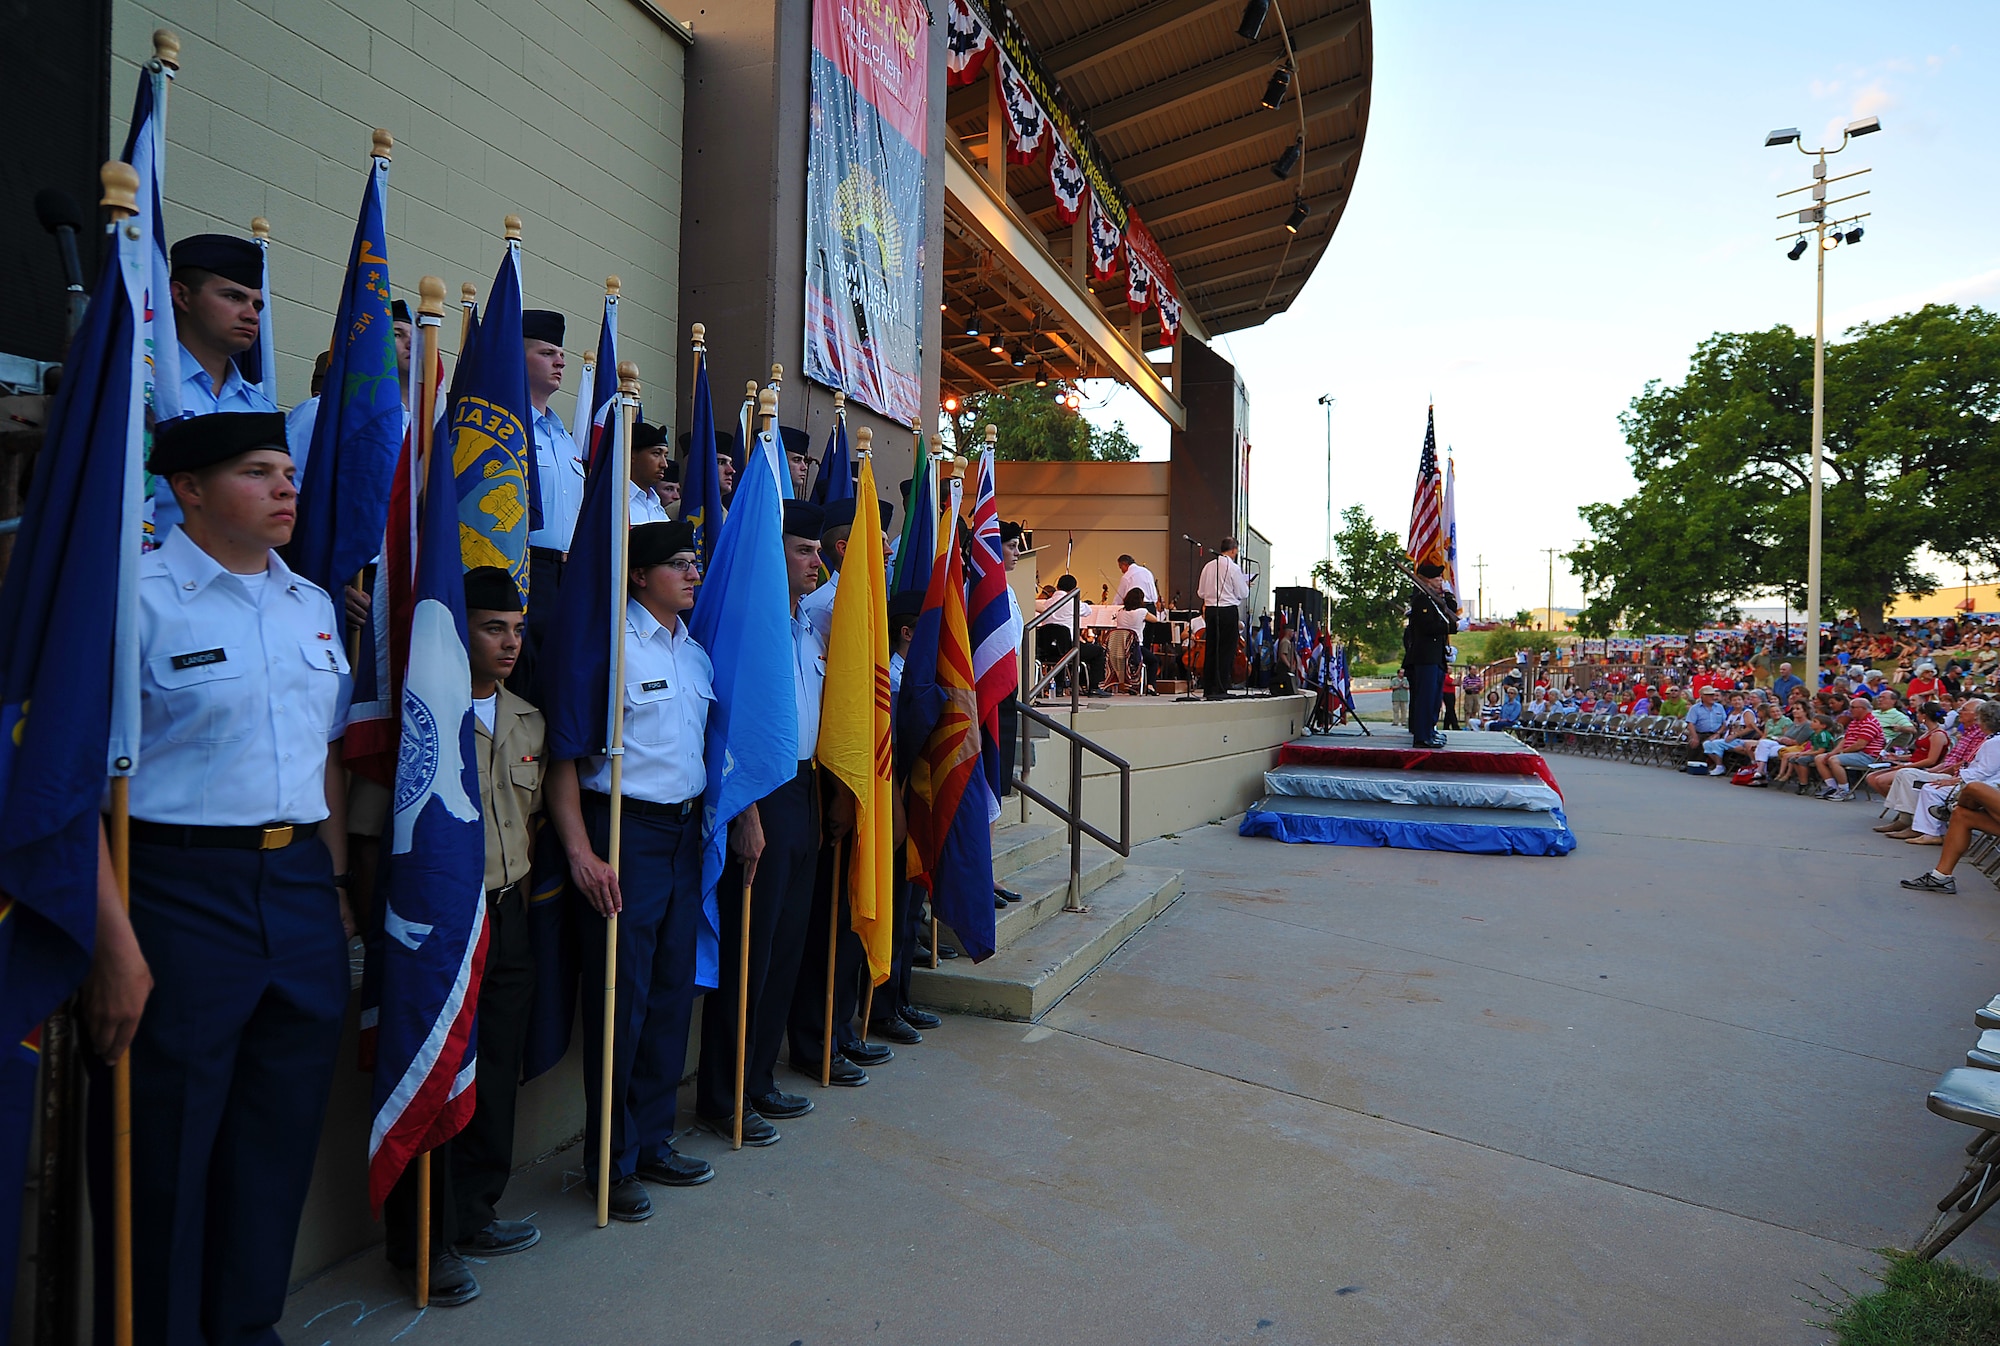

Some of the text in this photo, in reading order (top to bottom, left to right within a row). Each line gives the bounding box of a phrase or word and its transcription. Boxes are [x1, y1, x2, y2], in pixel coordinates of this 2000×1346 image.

[1004, 27, 1128, 229] July 3rd Pops Concet presented by
[833, 254, 858, 283] SAN
[182, 653, 216, 666] LANDIS
